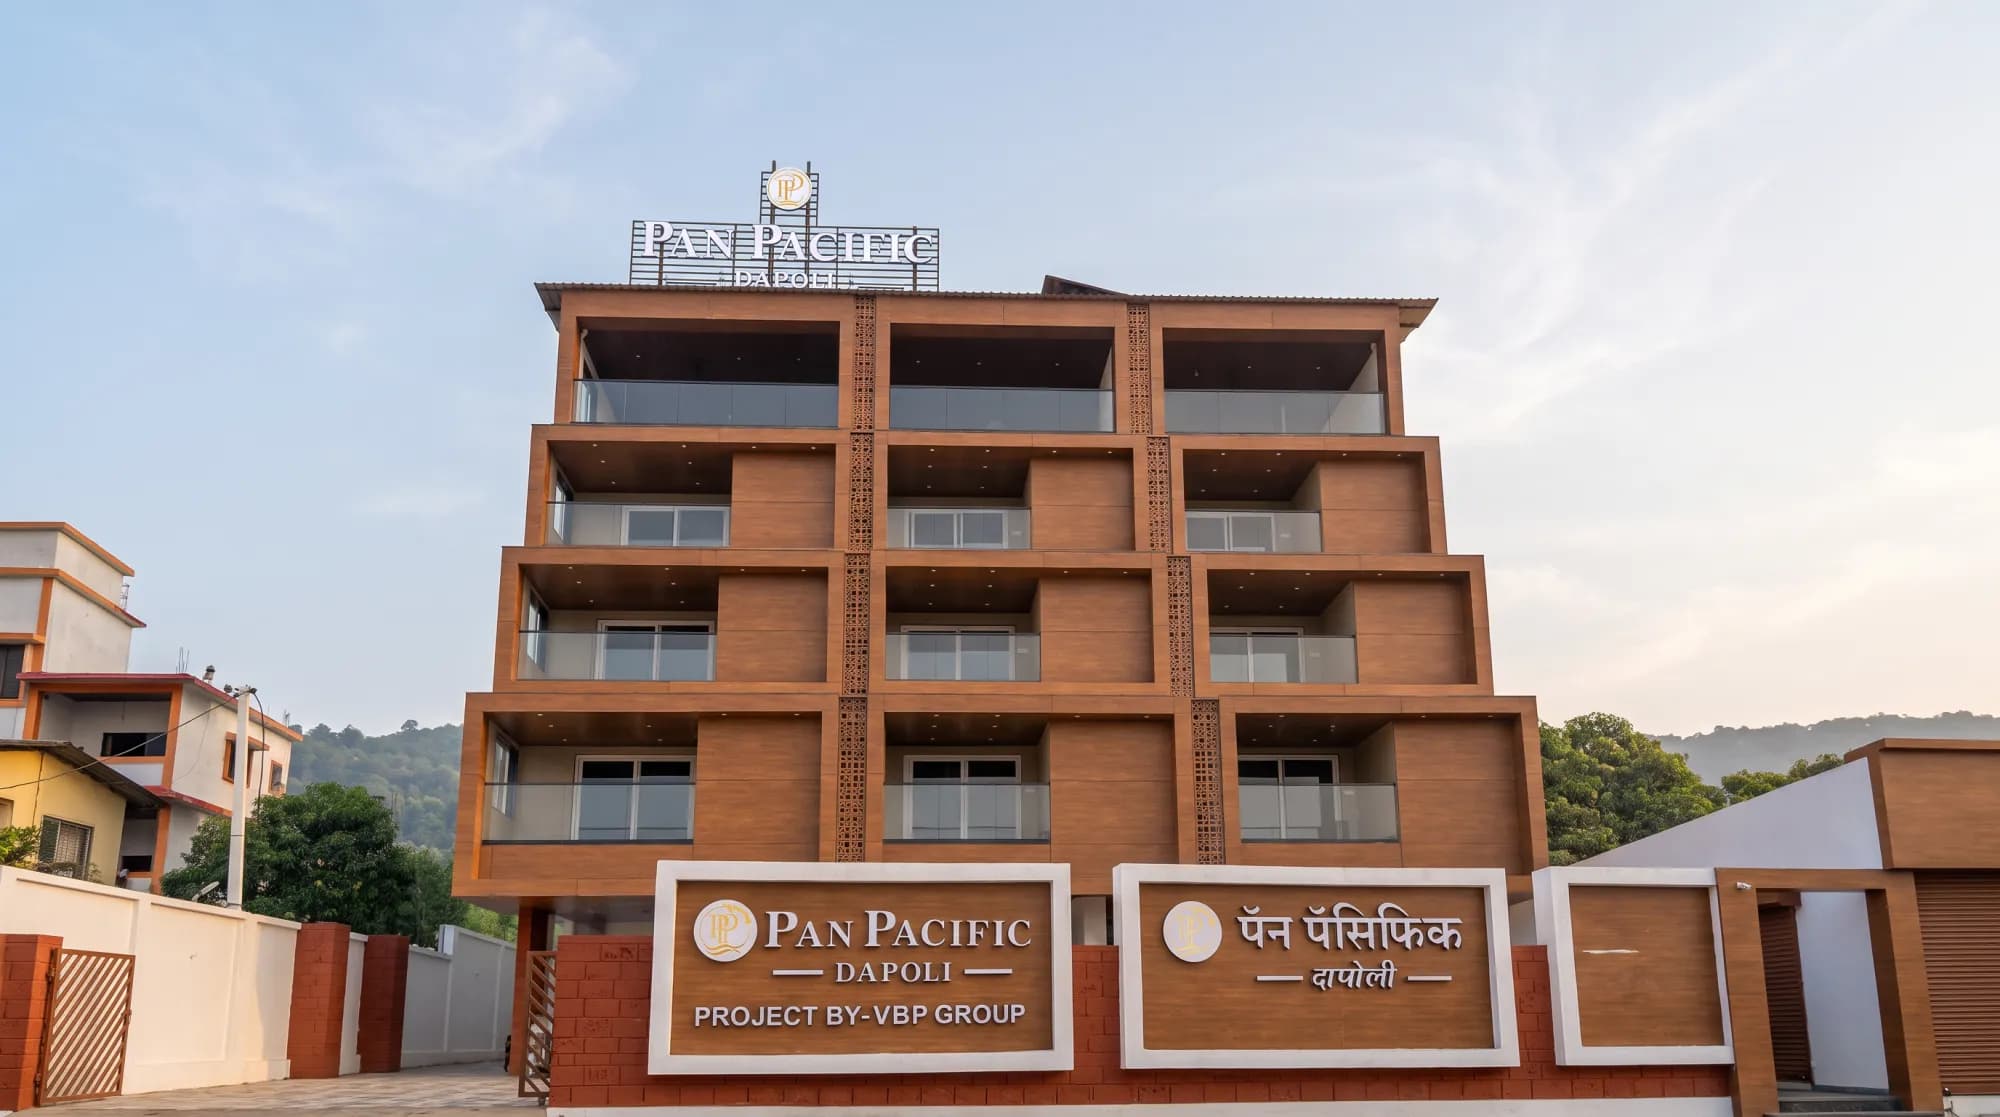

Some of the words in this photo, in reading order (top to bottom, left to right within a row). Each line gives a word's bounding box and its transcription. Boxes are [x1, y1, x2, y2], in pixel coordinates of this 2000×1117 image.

[642, 221, 733, 259] PAN
[751, 224, 934, 264] PACIFIC
[734, 270, 834, 289] DAPOLI
[765, 911, 854, 949] PAN
[864, 910, 1032, 948] PACIFIC
[1237, 905, 1294, 951] पॅन
[1302, 902, 1464, 951] पॅसिफिक
[835, 962, 952, 983] DAPOLI
[1311, 960, 1397, 991] दापोली
[694, 1006, 818, 1027] PROJECT
[934, 1004, 1026, 1025] GROUP
